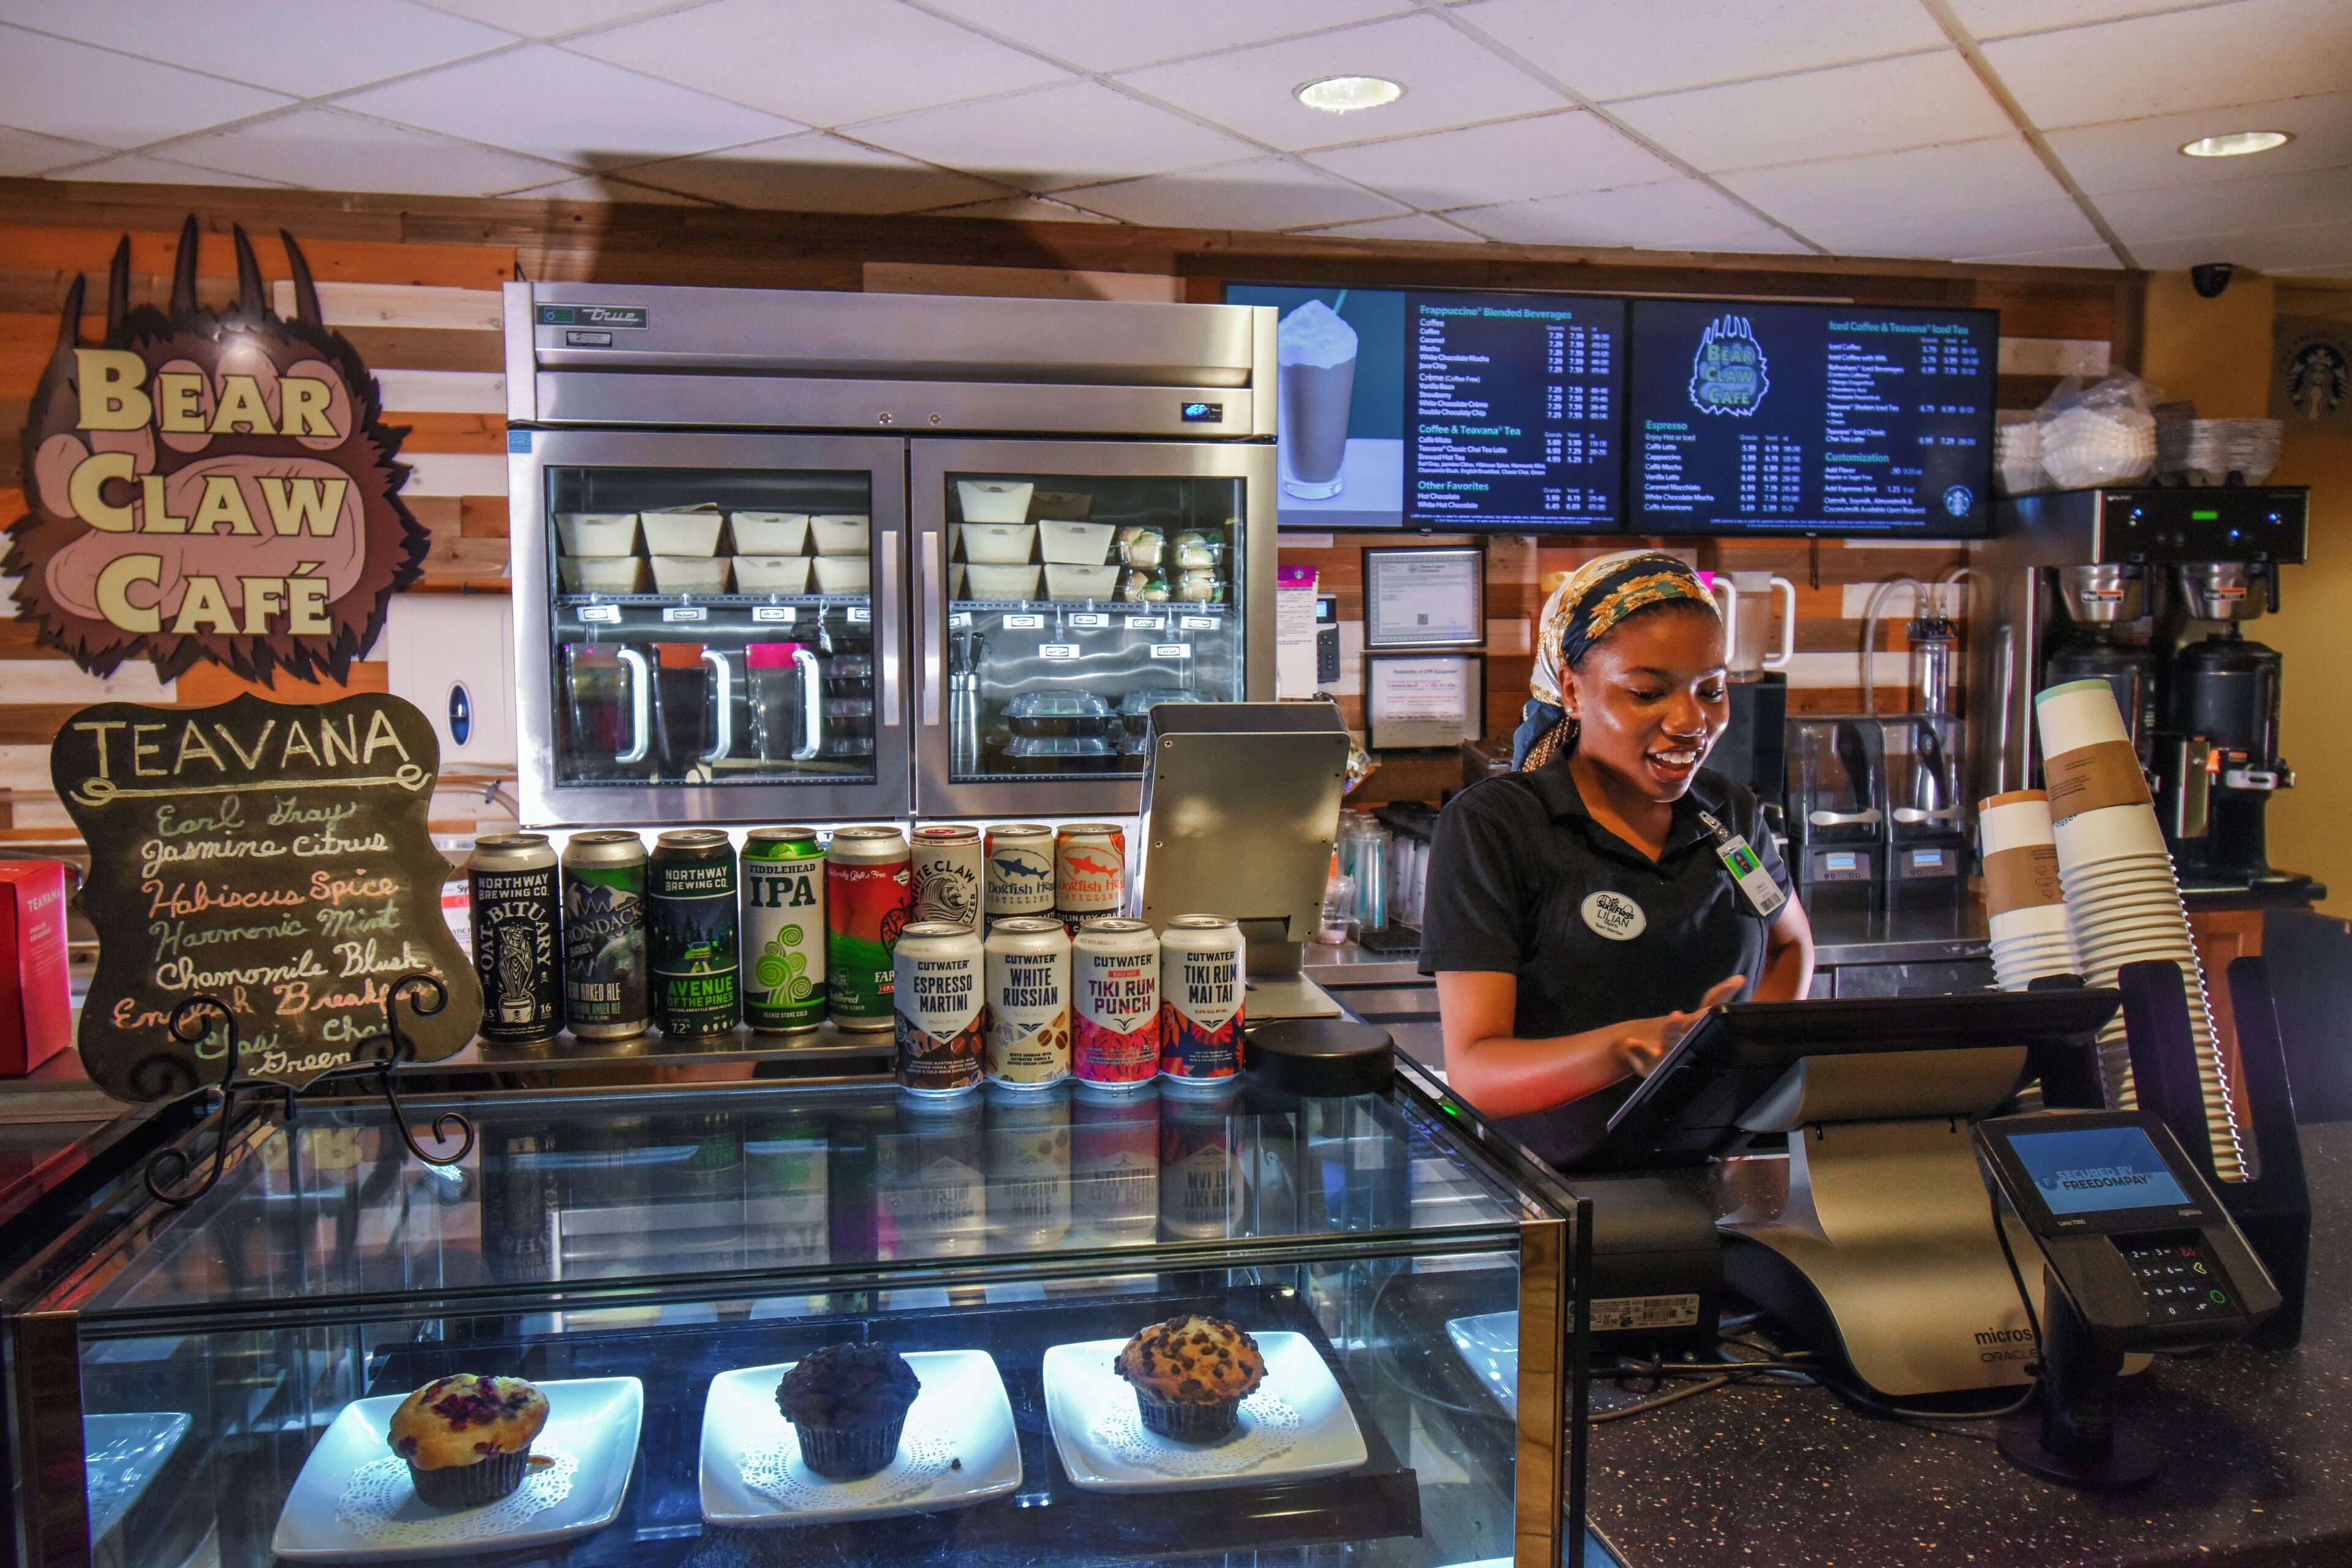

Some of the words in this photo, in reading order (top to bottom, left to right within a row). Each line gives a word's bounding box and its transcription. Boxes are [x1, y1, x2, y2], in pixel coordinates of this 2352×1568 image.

[1420, 318, 1445, 327] Coffee
[1483, 307, 1523, 317] Blended
[1524, 309, 1572, 320] Beverages
[1707, 344, 1753, 363] BEAR
[1705, 366, 1754, 383] CLAW
[73, 348, 342, 437] BEAR
[1419, 424, 1450, 434] Coffee
[1451, 425, 1458, 434] &
[1504, 426, 1521, 435] Tea
[1646, 420, 1688, 431] Espresso
[1826, 452, 1890, 462] Customization
[68, 451, 350, 537] CLAW
[1418, 481, 1445, 490] Other
[1446, 481, 1489, 491] Favorites
[95, 552, 333, 635] CAFÉ
[73, 709, 412, 778] TEAVANA
[157, 795, 244, 837] Earl
[141, 829, 287, 878] Jasmine
[292, 828, 388, 857] Citrus
[665, 865, 728, 880] NORTHWAY
[750, 863, 816, 874] FIDDLEHEAD
[870, 870, 886, 879] Free
[309, 869, 399, 900] Spice
[478, 873, 549, 889] NORTHWAY
[666, 878, 712, 892] BREWING
[714, 877, 728, 889] CO.
[911, 864, 932, 907] WHITE
[934, 860, 975, 883] CLAW
[989, 881, 1033, 895] Dogfish
[1059, 878, 1102, 893] Dogfish
[479, 888, 531, 900] BREWING
[533, 886, 549, 897] CO.
[750, 875, 816, 908] IPA
[1597, 900, 1611, 911] Six
[1615, 907, 1635, 920] Flags
[1597, 910, 1630, 928] LILIAN
[149, 913, 309, 962] Harmonic
[317, 899, 400, 938] Mint
[156, 949, 330, 992] Chamomile
[333, 940, 426, 978] Blush
[918, 960, 970, 971] CUTWATER
[1005, 954, 1057, 965] CUTWATER
[1094, 954, 1153, 968] CUTWATER
[1187, 951, 1235, 962] CUTWATER
[1009, 967, 1052, 987] WHITE
[1184, 965, 1210, 984] TIKI
[1213, 963, 1237, 984] RUM
[607, 982, 620, 1001] ALE
[668, 975, 733, 997] AVENUE
[913, 974, 973, 994] ESPRESSO
[1088, 979, 1120, 997] TIKI
[1125, 977, 1155, 996] RUM
[667, 997, 680, 1007] OF
[680, 997, 703, 1008] THE
[705, 992, 734, 1006] PINES
[919, 993, 968, 1012] MARTINI
[1003, 987, 1058, 1007] RUSSIAN
[1188, 984, 1212, 1005] MAI
[1217, 983, 1233, 1003] TAI
[540, 1003, 551, 1013] 16
[1094, 995, 1150, 1014] PUNCH
[322, 1014, 391, 1041] Chai
[248, 1049, 352, 1077] Green
[2056, 1167, 2116, 1180] SECURED
[2117, 1166, 2133, 1176] BY
[2063, 1174, 2148, 1191] FREEDOMPAY
[1973, 1327, 2034, 1346] micros
